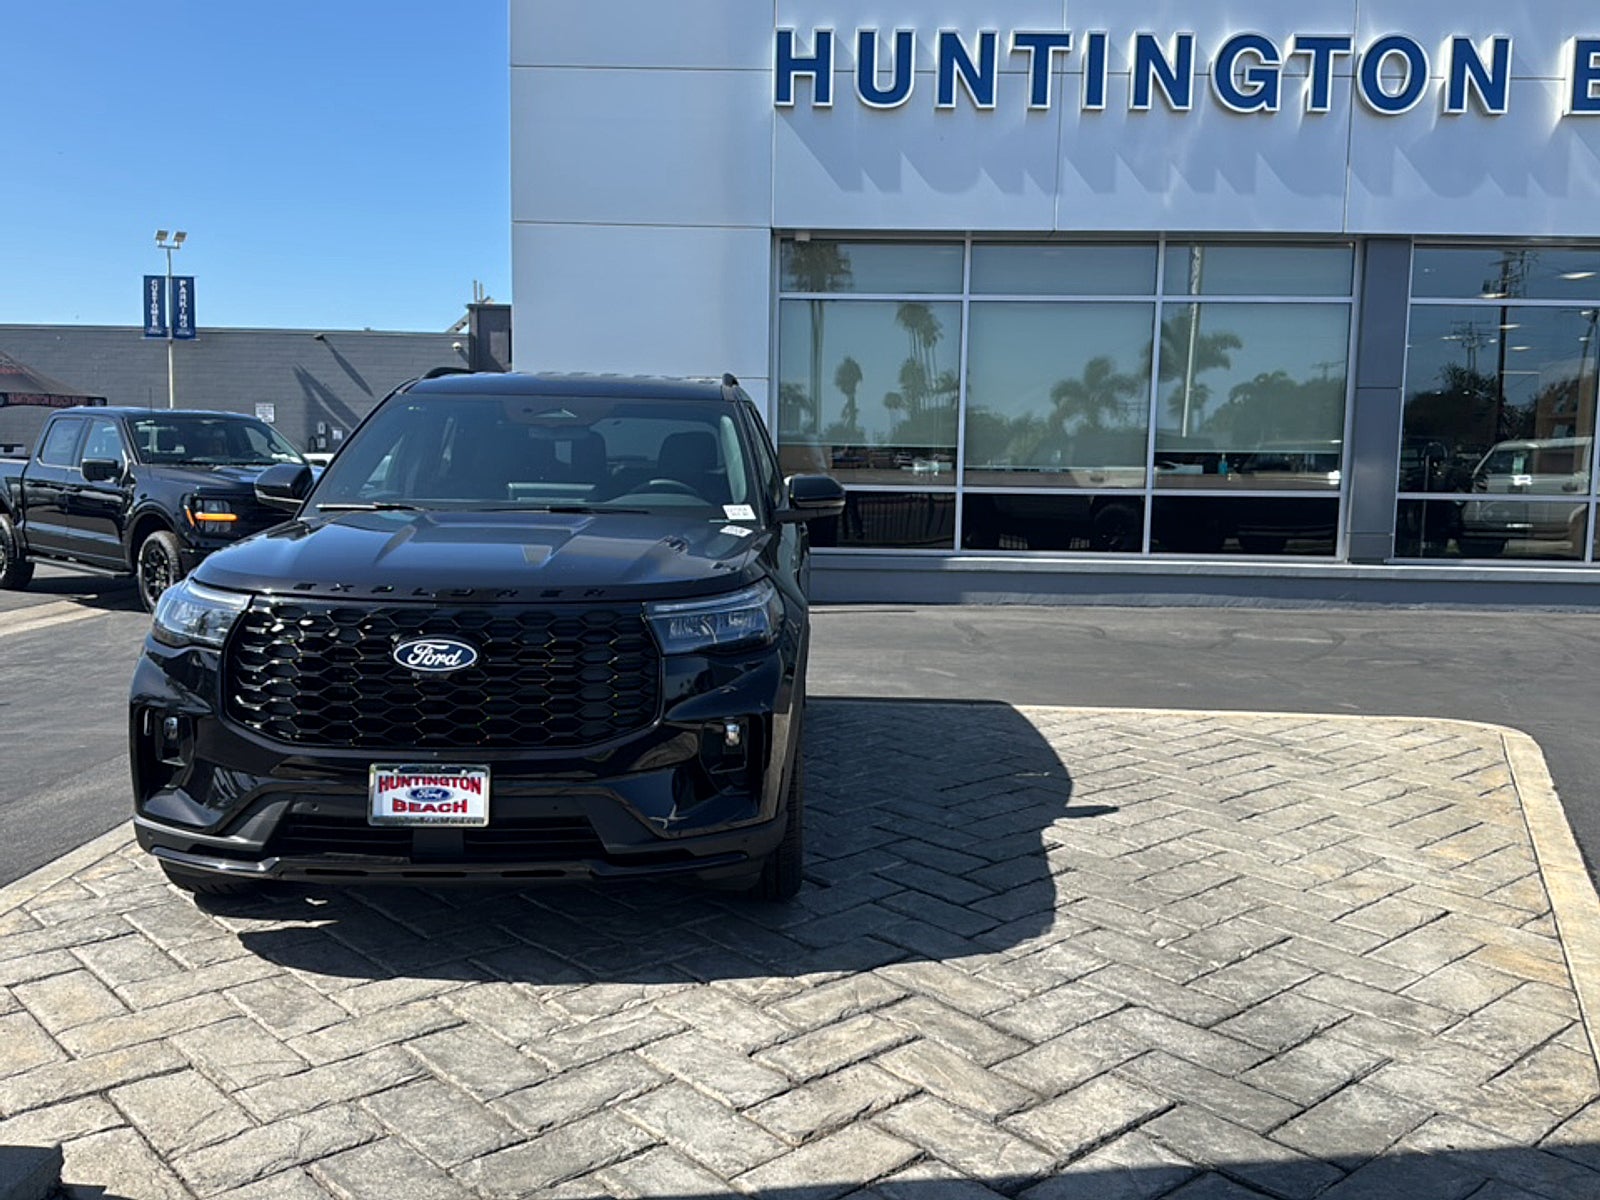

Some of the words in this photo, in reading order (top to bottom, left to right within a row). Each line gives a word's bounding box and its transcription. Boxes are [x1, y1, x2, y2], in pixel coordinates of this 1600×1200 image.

[774, 27, 1513, 114] HUNTINGTON
[151, 279, 159, 328] CUSTOMER
[179, 279, 188, 328] PARKING
[293, 582, 606, 599] EXPLORER
[405, 642, 464, 667] Ford
[378, 775, 482, 795] HUNTINGTON
[392, 798, 468, 813] BEACH
